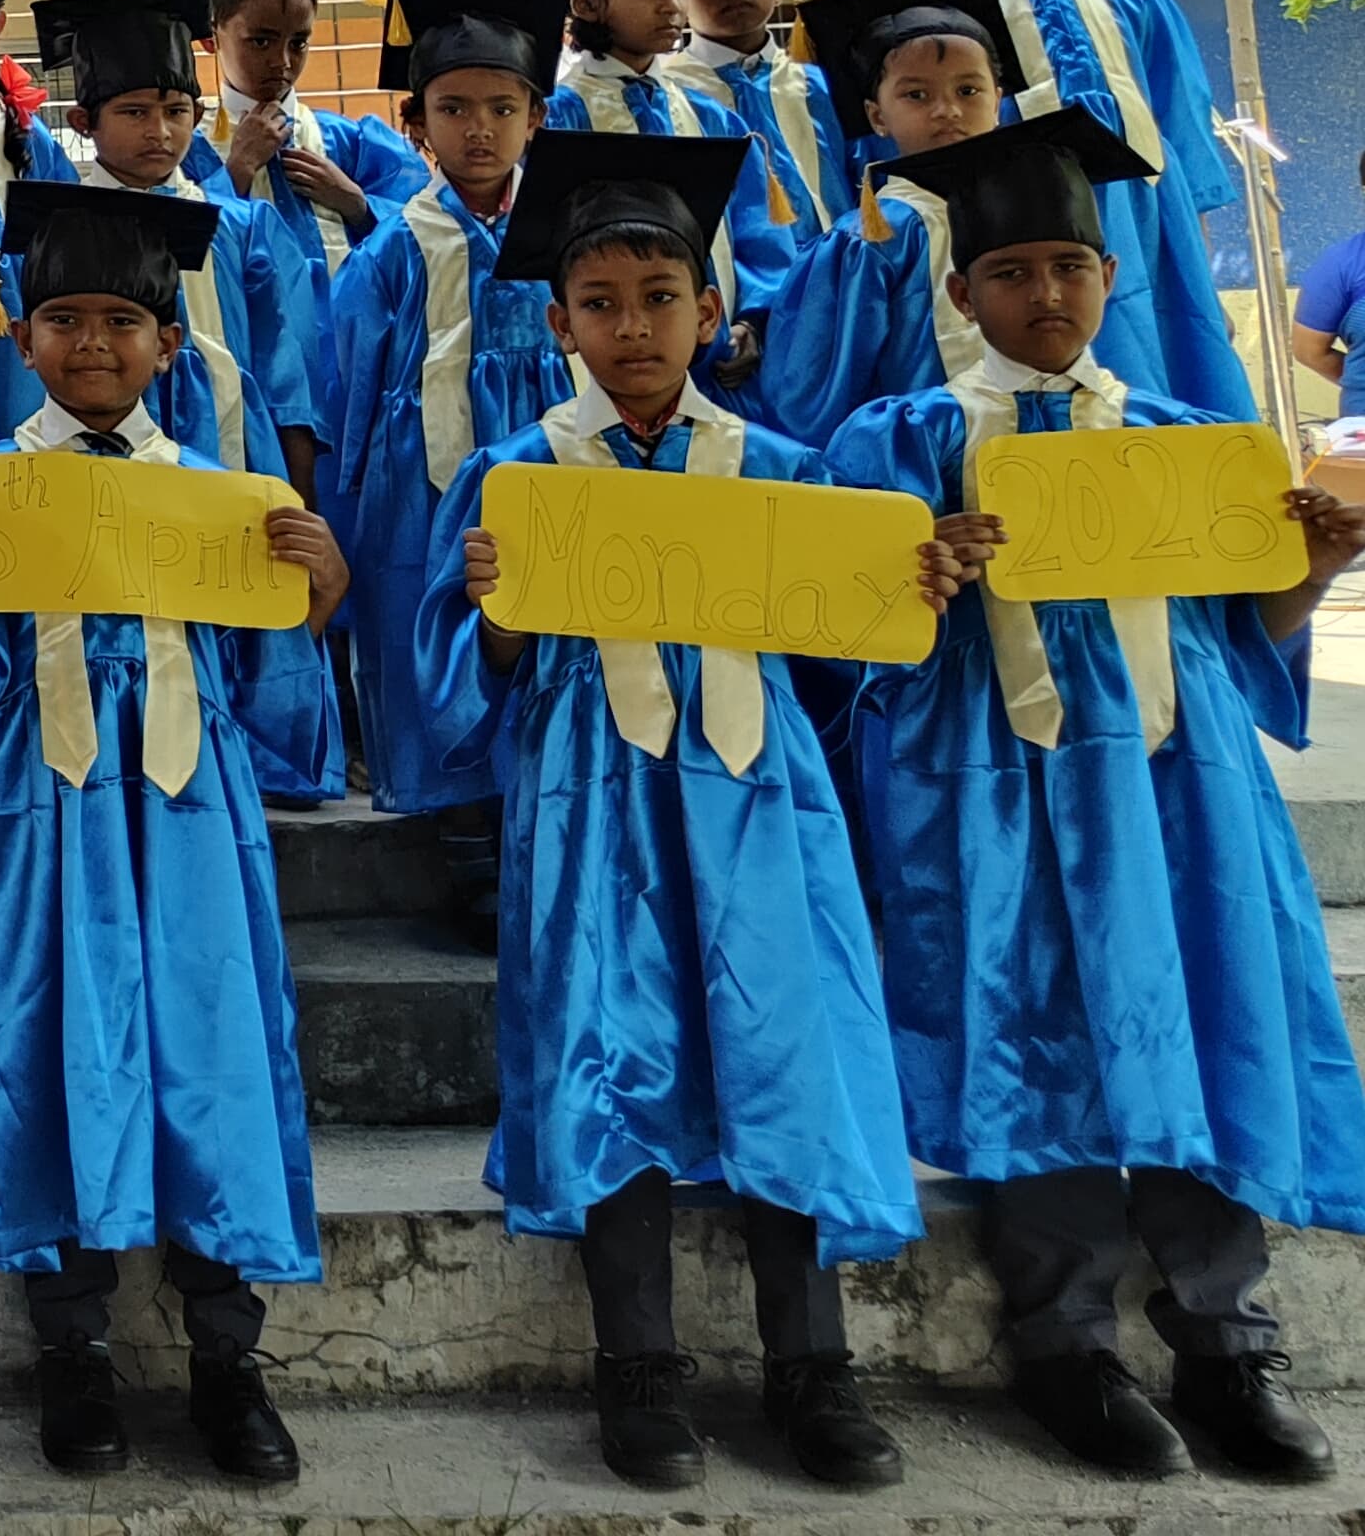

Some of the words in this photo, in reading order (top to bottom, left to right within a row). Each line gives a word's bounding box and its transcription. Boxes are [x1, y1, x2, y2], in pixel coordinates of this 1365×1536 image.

[64, 464, 280, 616] April
[499, 478, 909, 657] Monday
[981, 434, 1279, 577] 2026
